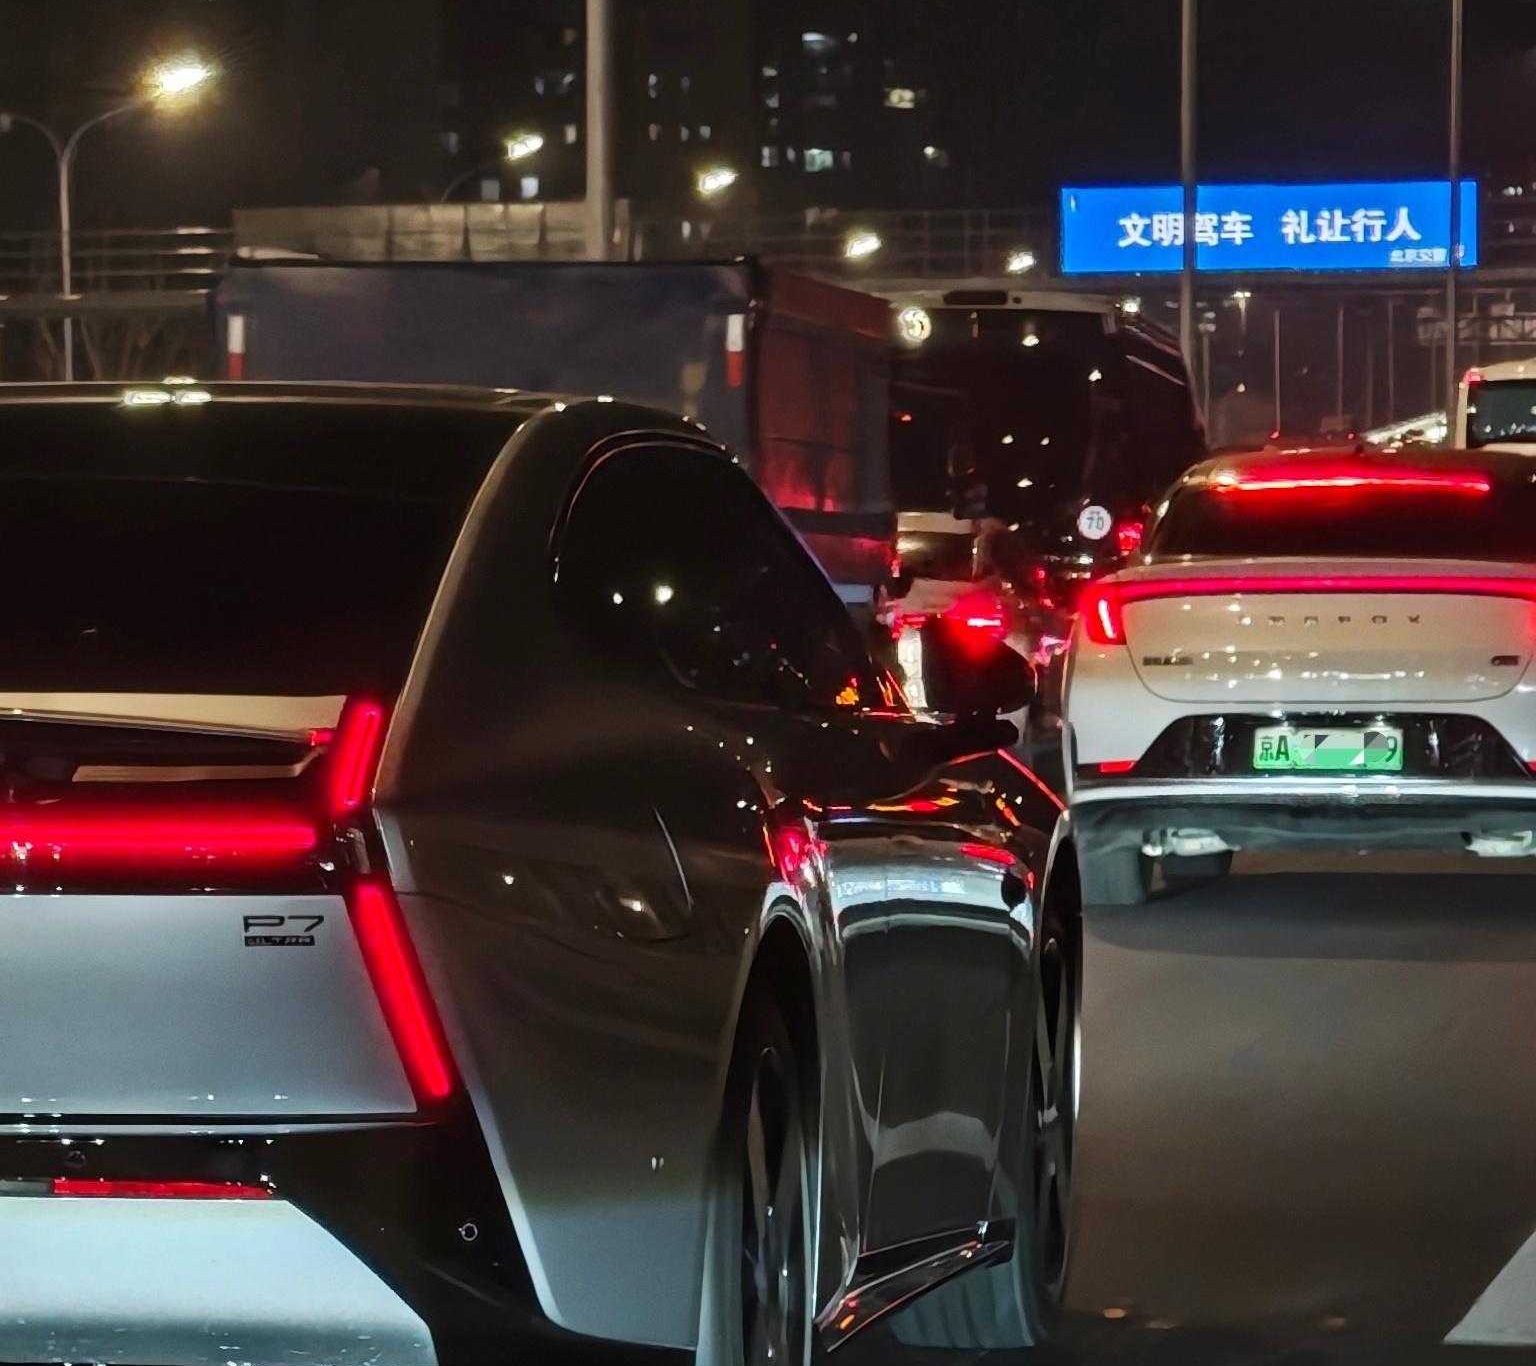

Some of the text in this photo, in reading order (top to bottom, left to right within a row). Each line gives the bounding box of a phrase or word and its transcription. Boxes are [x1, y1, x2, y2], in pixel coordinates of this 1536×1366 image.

[1118, 207, 1422, 247] 文明驾车 礼让行人
[243, 915, 324, 932] P7
